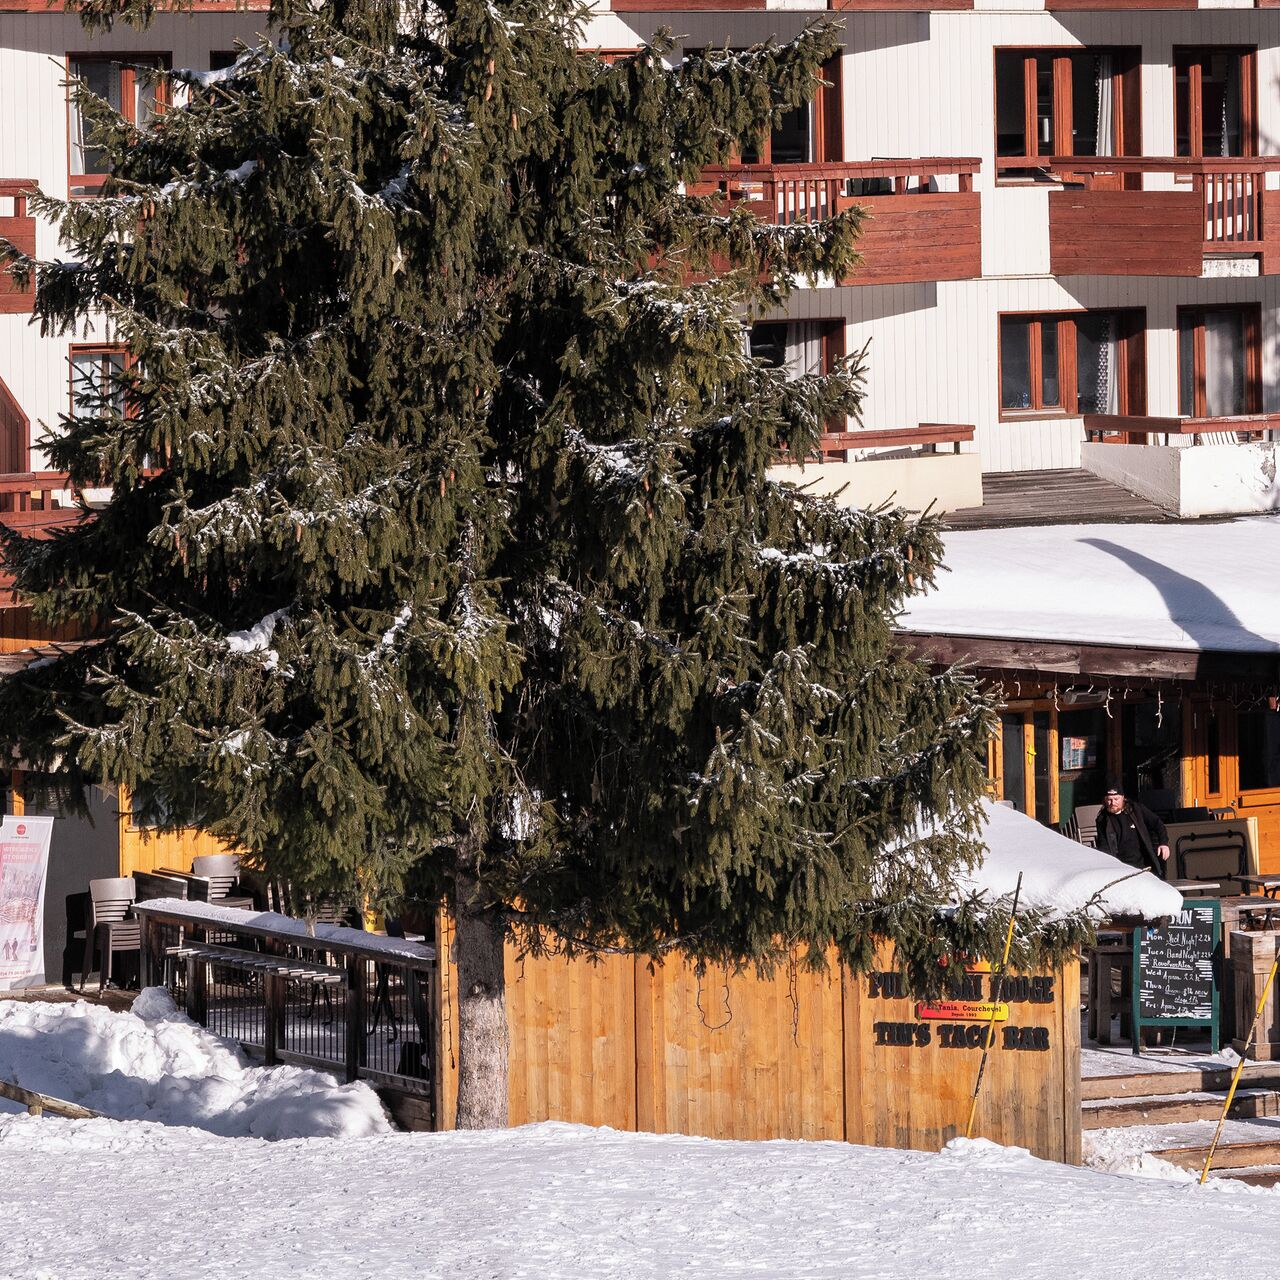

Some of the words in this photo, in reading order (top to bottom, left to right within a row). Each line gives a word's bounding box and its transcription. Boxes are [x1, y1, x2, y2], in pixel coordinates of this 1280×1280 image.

[988, 975, 1055, 1004] LODGE
[936, 1023, 996, 1051] TACO
[1001, 1026, 1051, 1052] BAR
